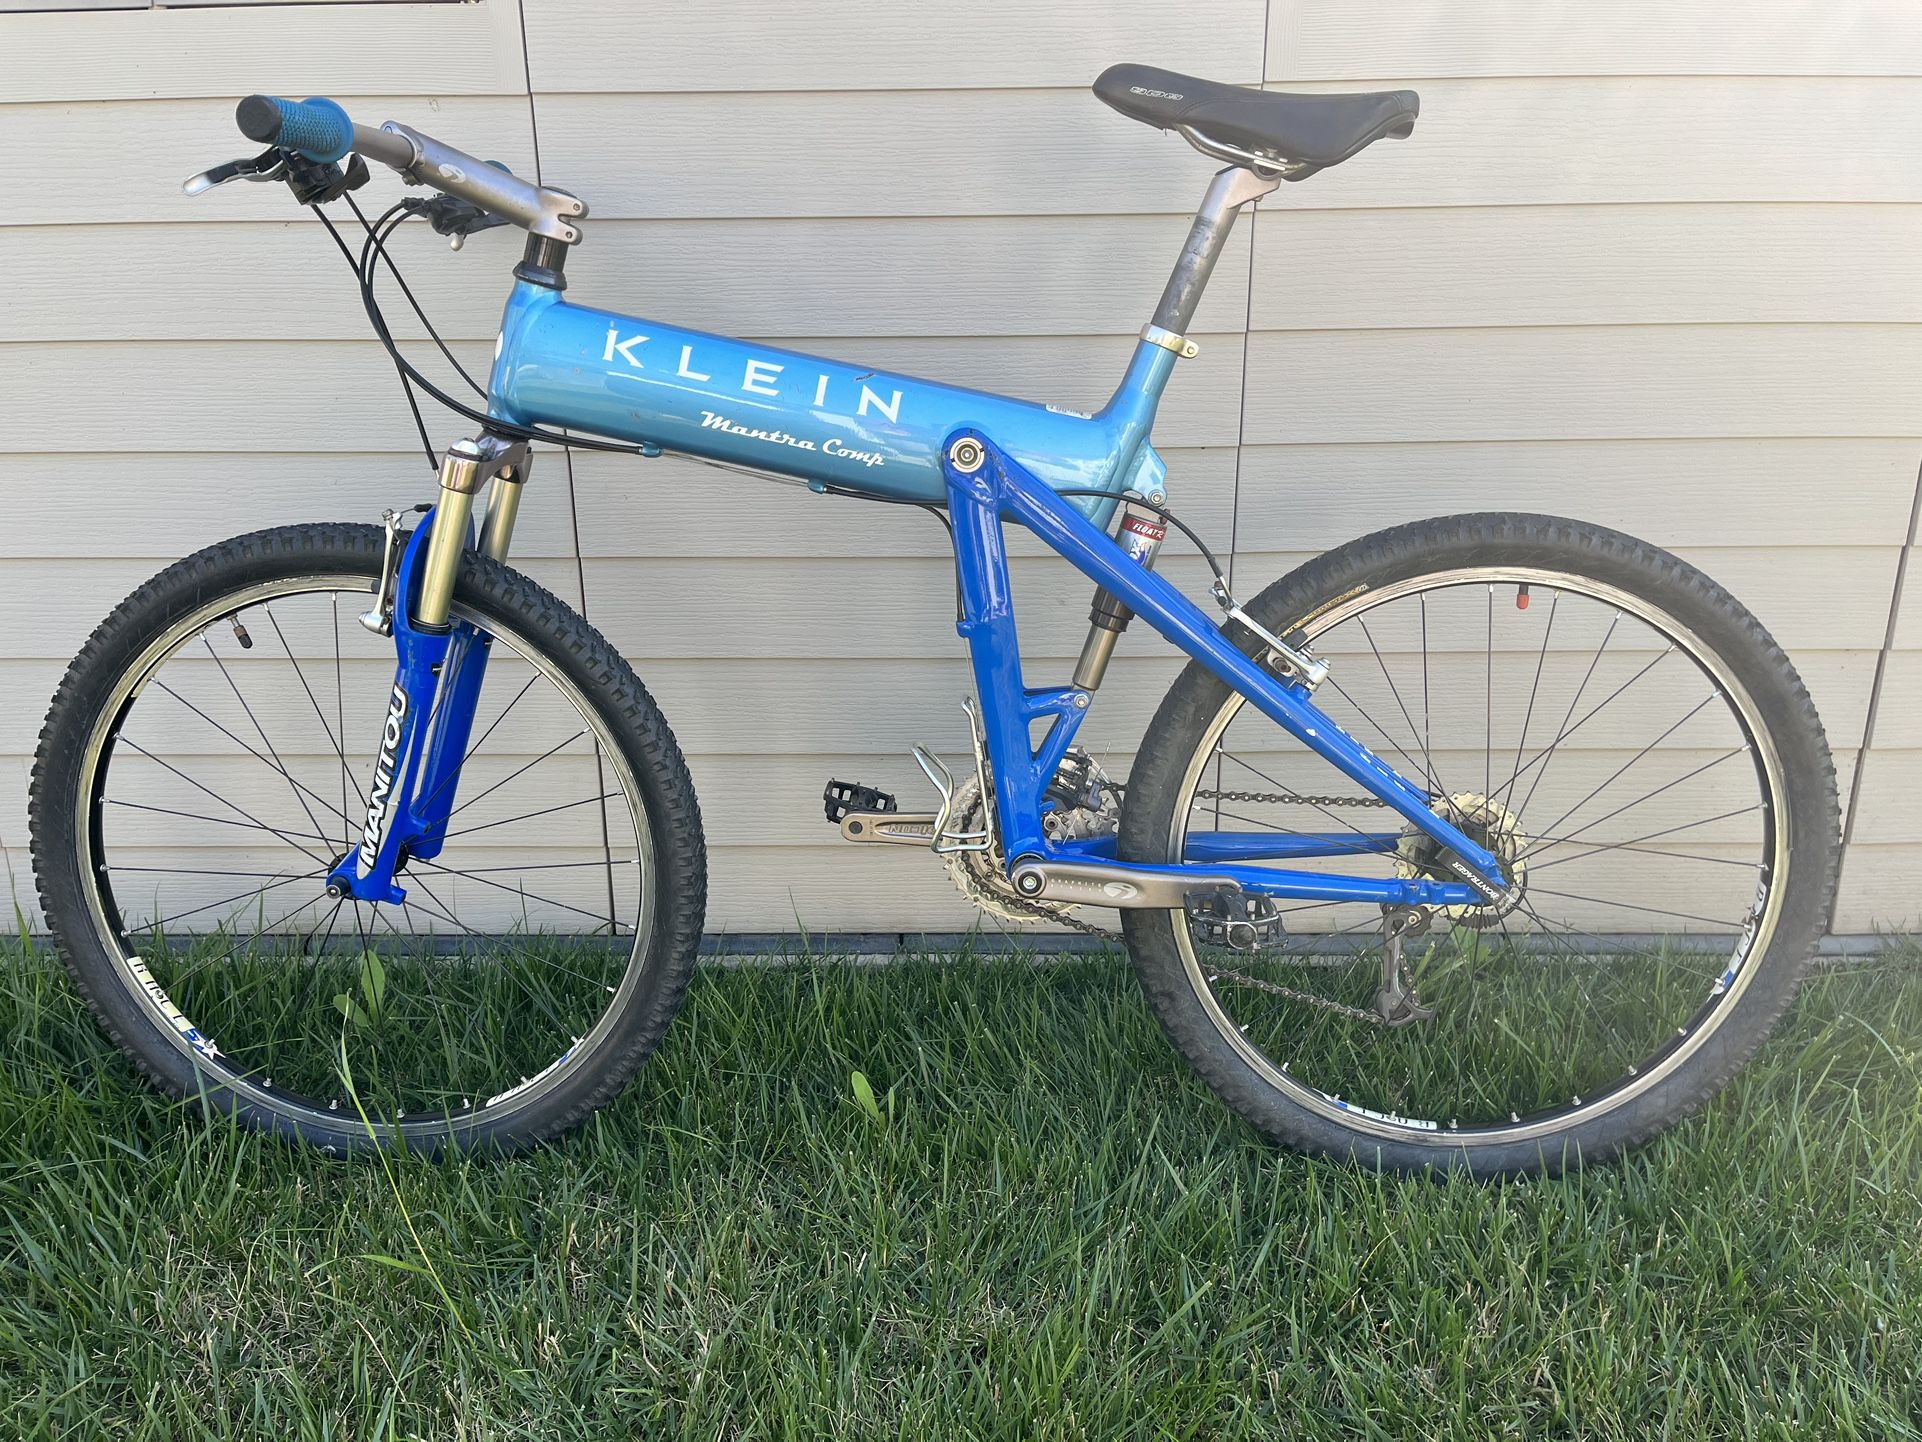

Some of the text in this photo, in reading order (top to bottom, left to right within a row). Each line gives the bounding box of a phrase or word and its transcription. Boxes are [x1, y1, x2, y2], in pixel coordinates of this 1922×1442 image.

[602, 329, 904, 424] KLEIN
[700, 411, 885, 467] Mantra Comp
[360, 684, 408, 869] MANITOU
[1452, 862, 1500, 900] BONTRAGER
